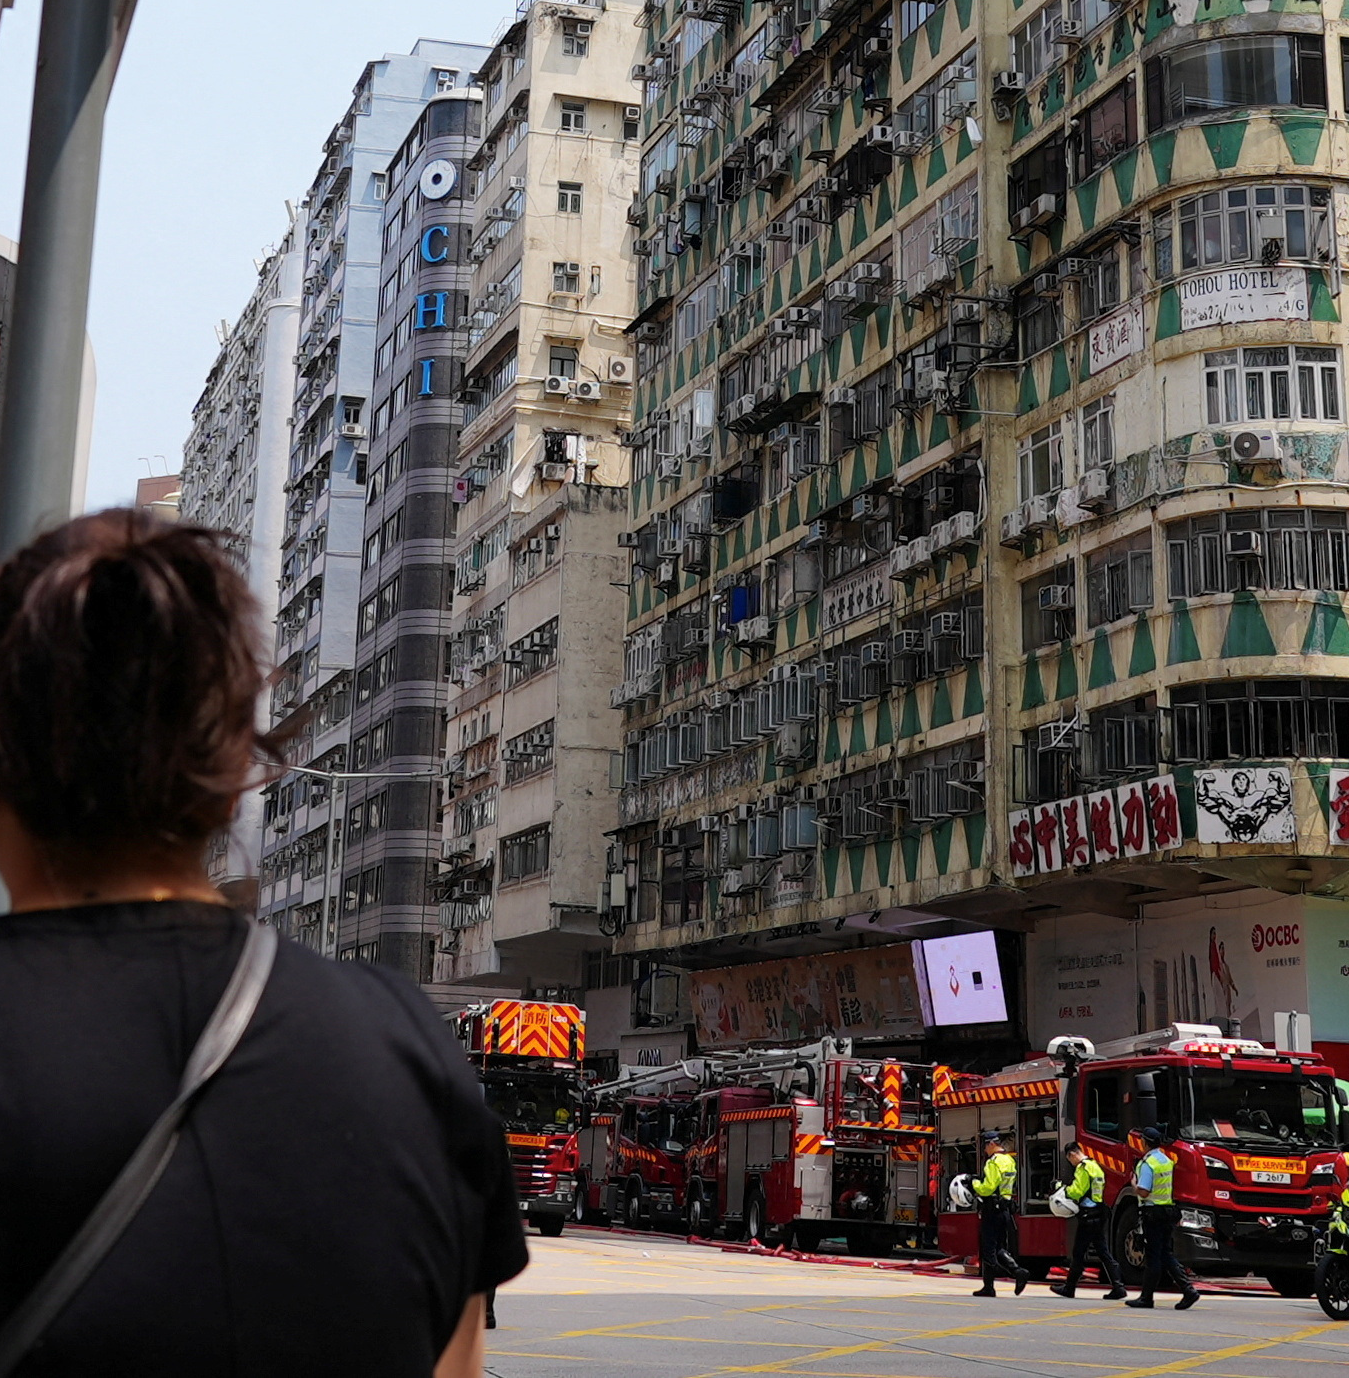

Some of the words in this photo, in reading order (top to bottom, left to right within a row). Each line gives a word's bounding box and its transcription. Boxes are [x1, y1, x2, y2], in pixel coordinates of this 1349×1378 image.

[1182, 275, 1223, 299] TOHOU
[1229, 271, 1279, 290] HOTEL
[1265, 923, 1300, 948] OCBC
[1266, 1174, 1284, 1182] 2617
